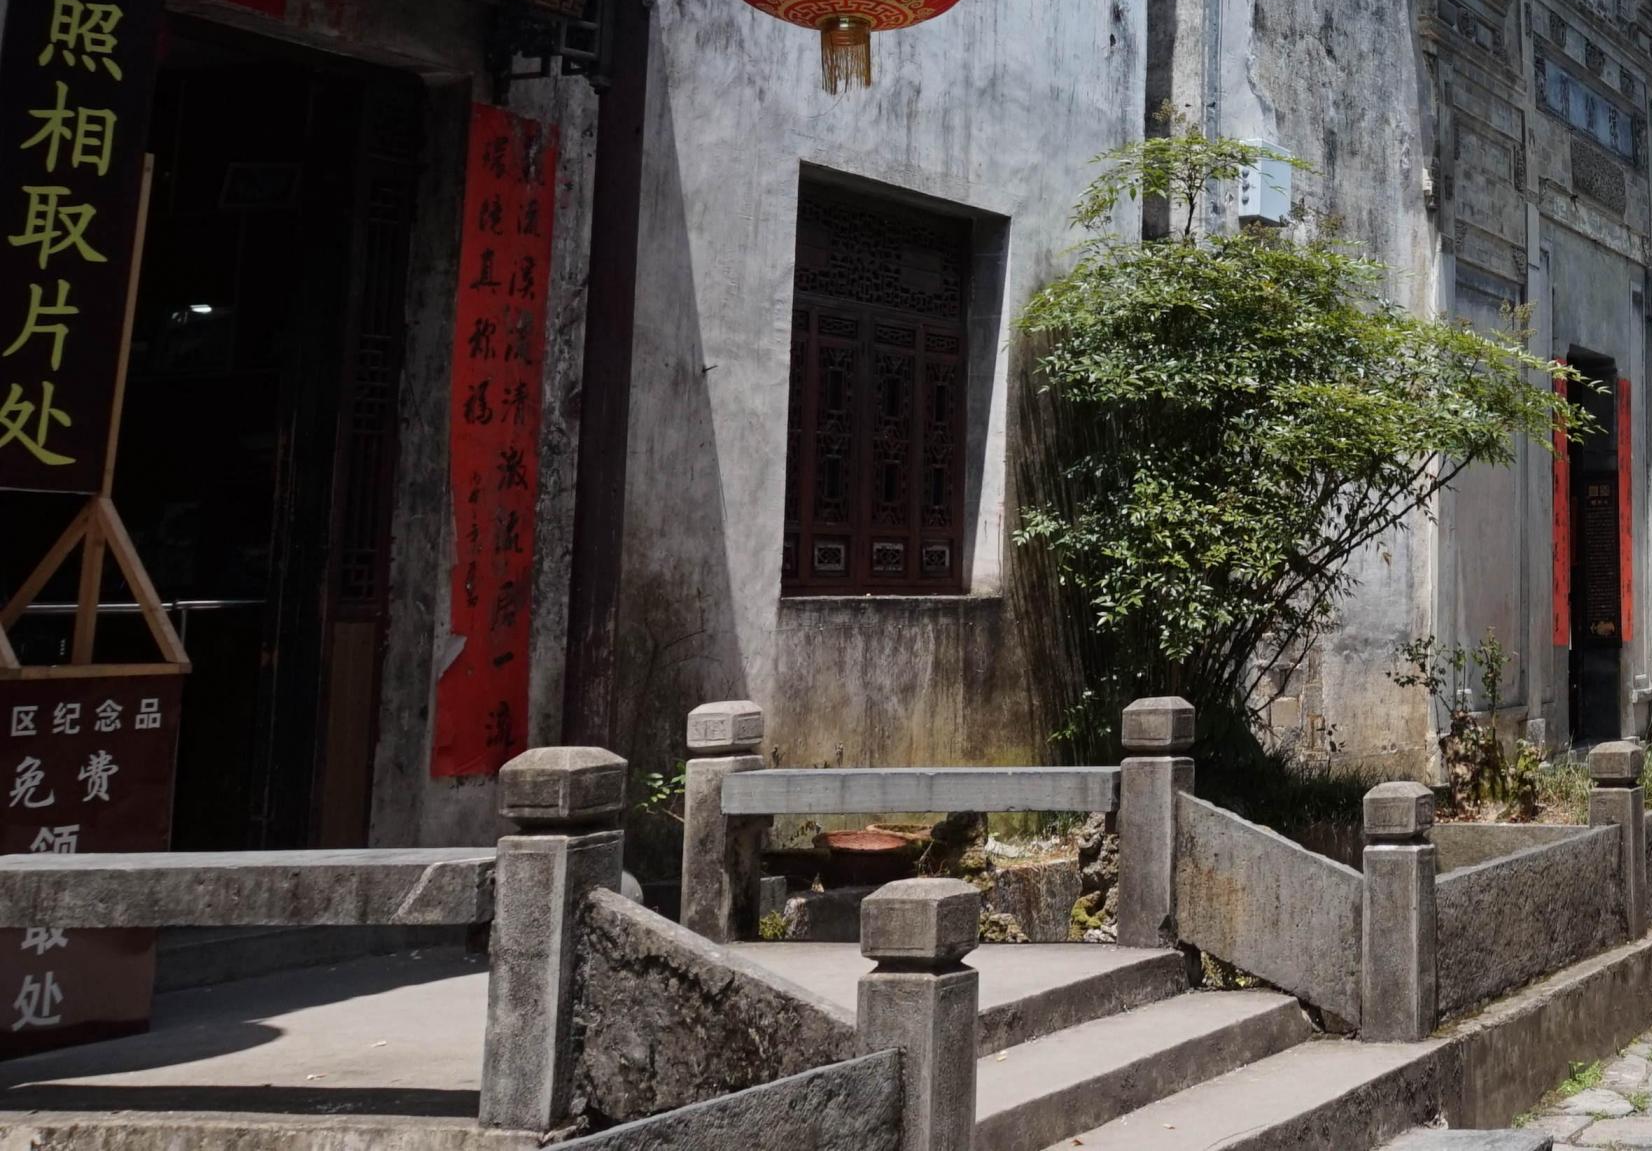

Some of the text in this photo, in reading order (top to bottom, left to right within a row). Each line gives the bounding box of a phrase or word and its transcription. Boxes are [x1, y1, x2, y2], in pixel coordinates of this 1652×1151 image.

[10, 697, 162, 737] 区纪念品
[8, 750, 120, 809] 免费
